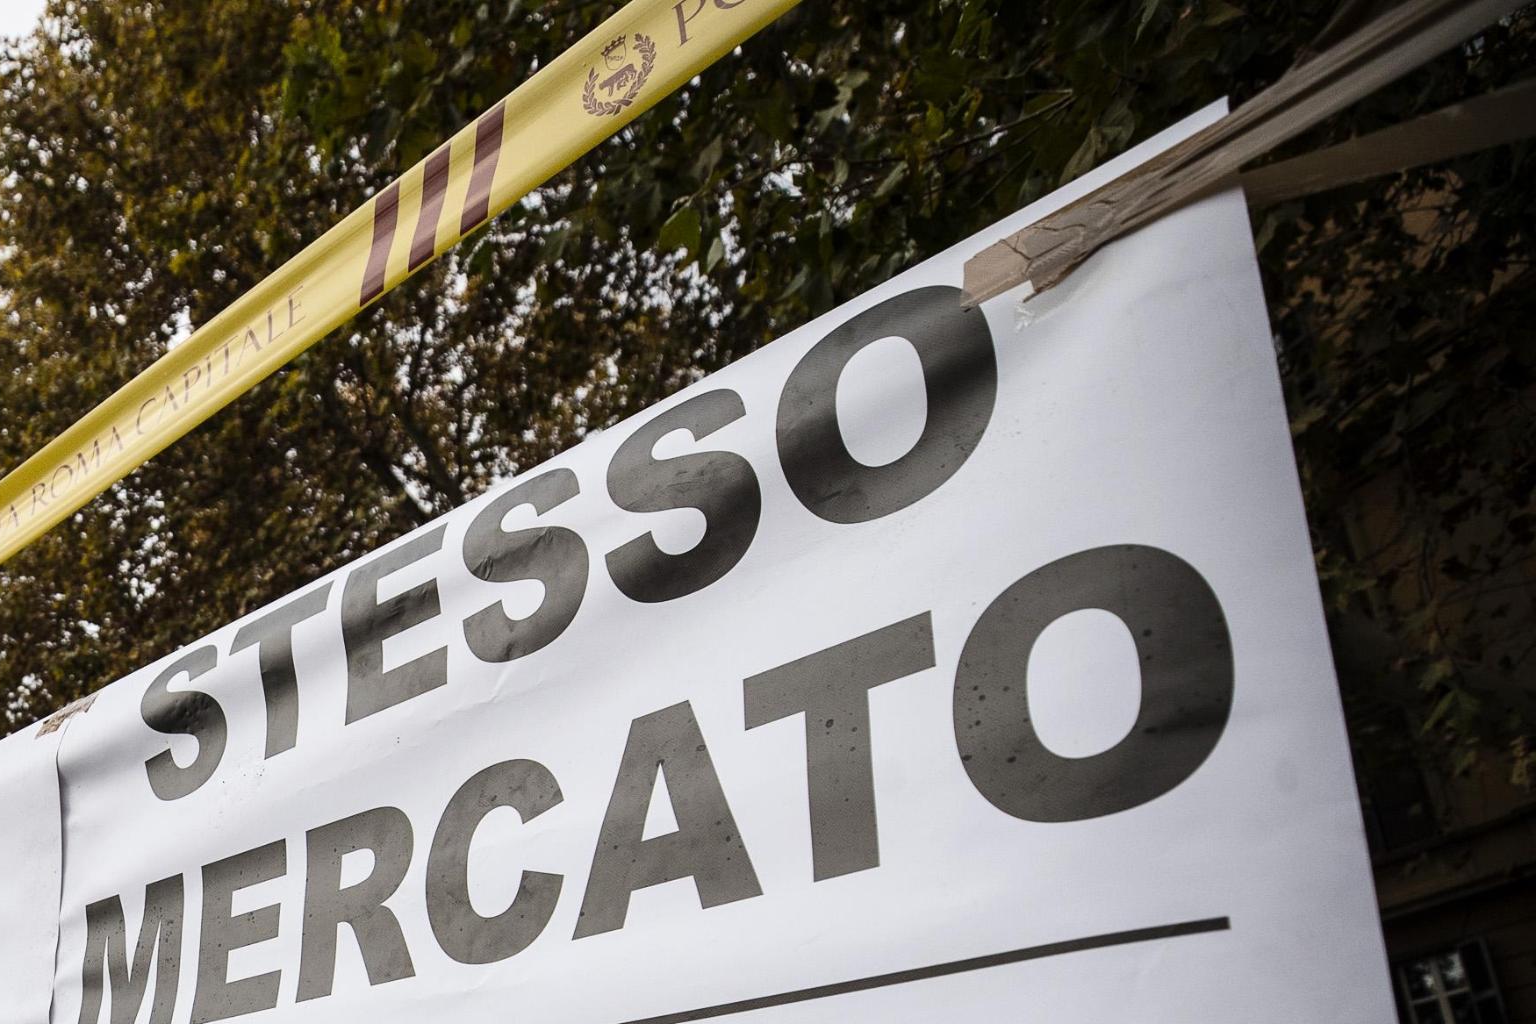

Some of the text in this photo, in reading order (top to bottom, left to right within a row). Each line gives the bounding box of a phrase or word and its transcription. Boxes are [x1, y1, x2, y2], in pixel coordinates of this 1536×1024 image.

[30, 426, 124, 516] ROMA
[136, 284, 307, 434] CAPITALE
[140, 285, 999, 803] STESSO
